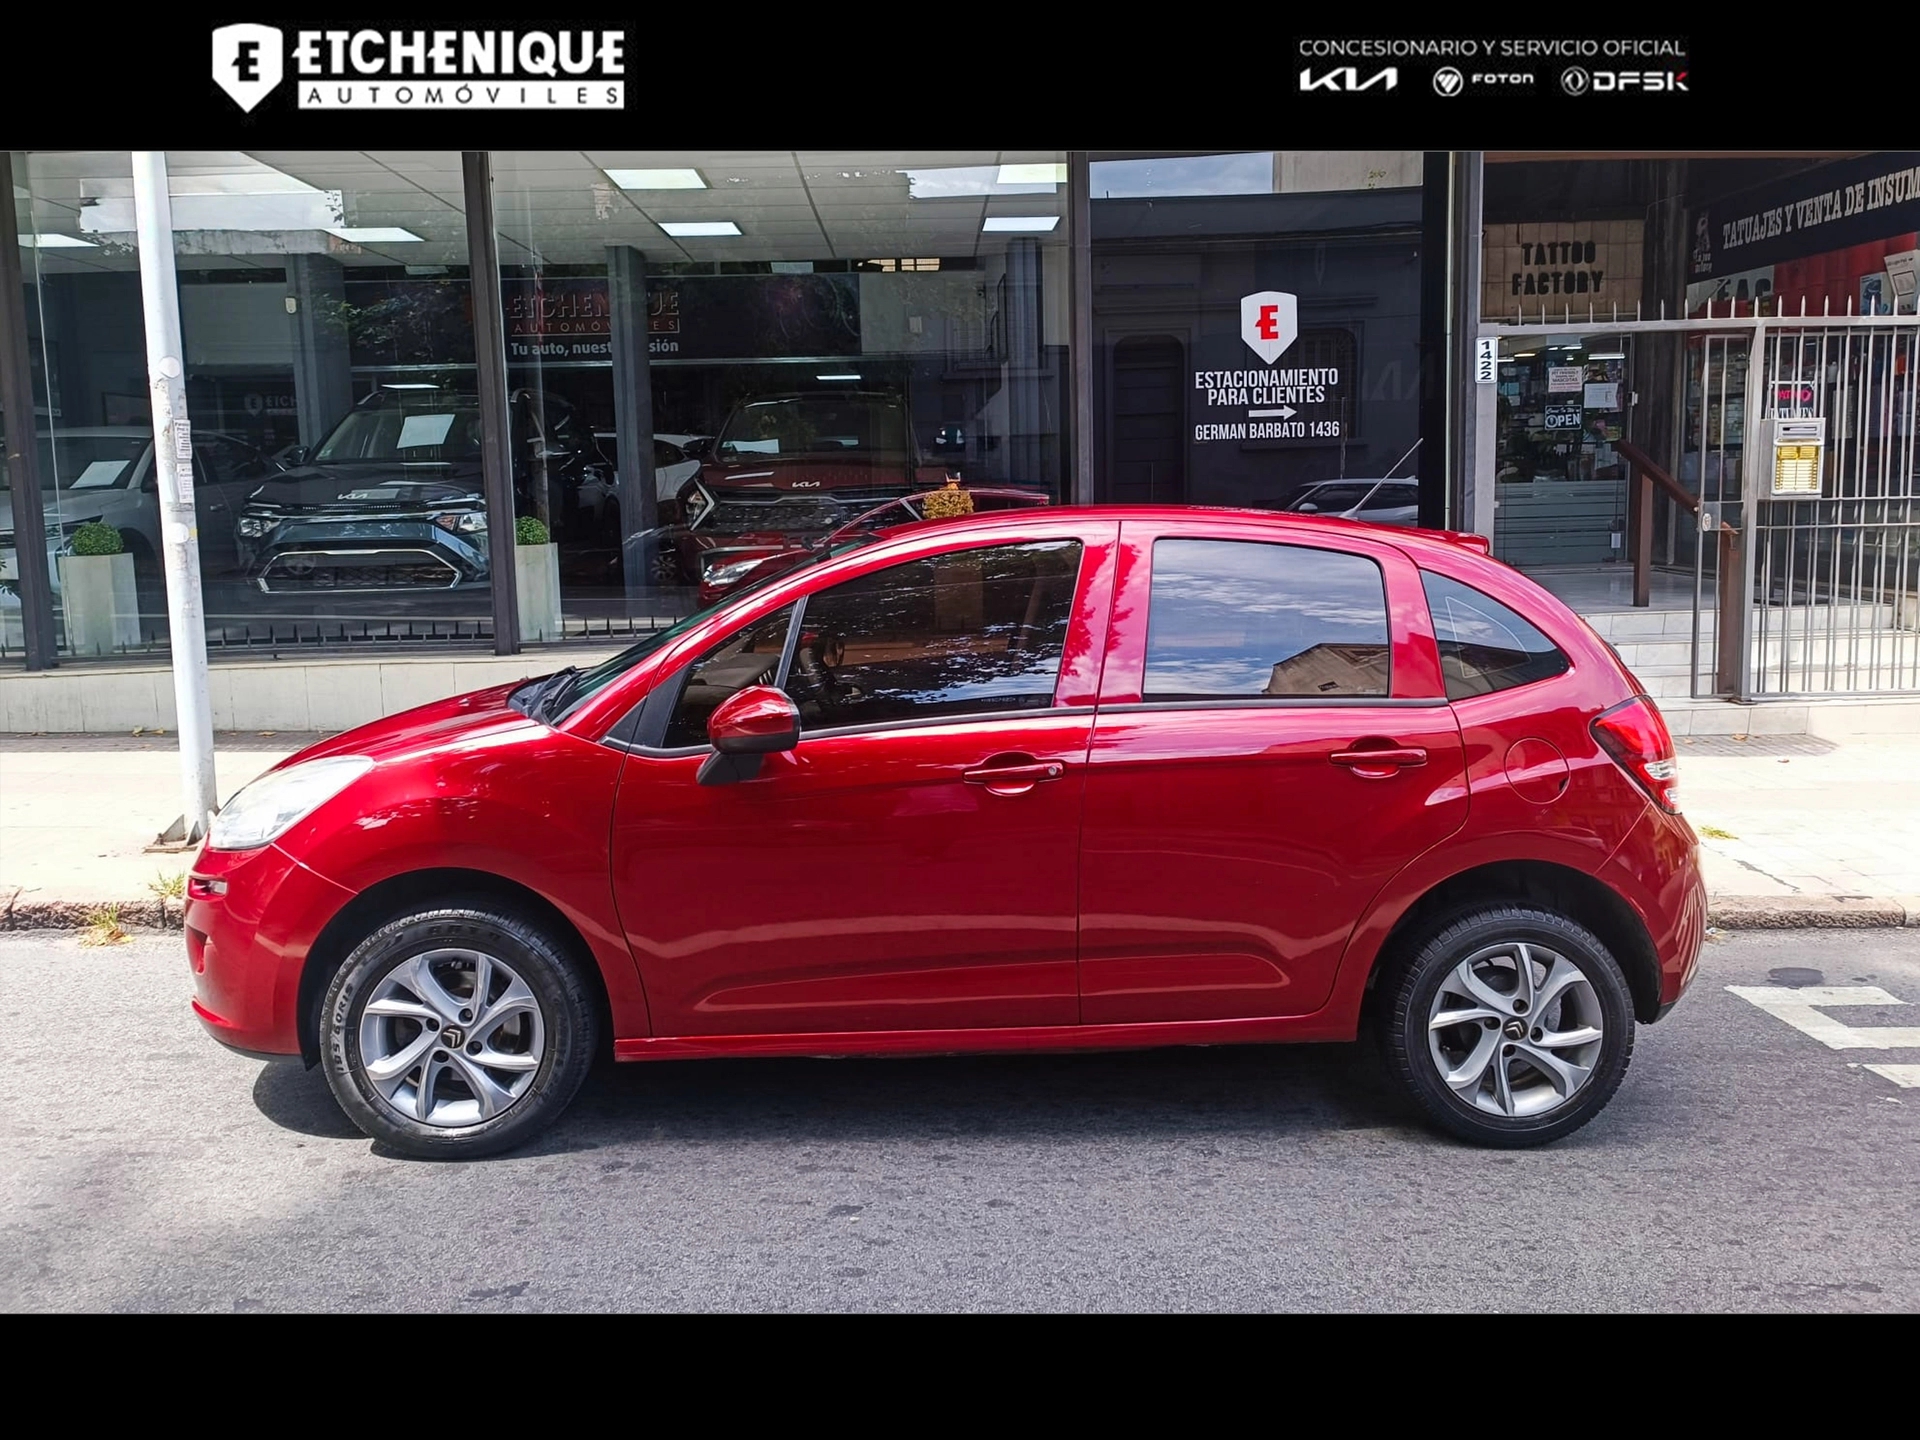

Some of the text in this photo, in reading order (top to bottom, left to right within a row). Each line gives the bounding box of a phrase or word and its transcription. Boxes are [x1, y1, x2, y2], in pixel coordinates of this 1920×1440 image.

[1722, 207, 1783, 250] TATUAJES
[1784, 203, 1795, 233] Y
[1795, 189, 1842, 229] VENTA
[1844, 182, 1865, 217] DE
[1521, 240, 1596, 266] TATTOO
[1512, 270, 1604, 296] FACTORY
[505, 291, 680, 319] ETCHENUE
[514, 319, 675, 334] AUTOMÓES
[511, 338, 679, 357] Tu auto, nuest sión
[1480, 340, 1493, 380] 1422
[1194, 368, 1339, 389] ESTACIONAMIENTO
[1207, 386, 1325, 406] PARA CLIENTES
[1194, 421, 1340, 440] GERMAN BARBATO 1436
[1545, 413, 1580, 428] OPEN
